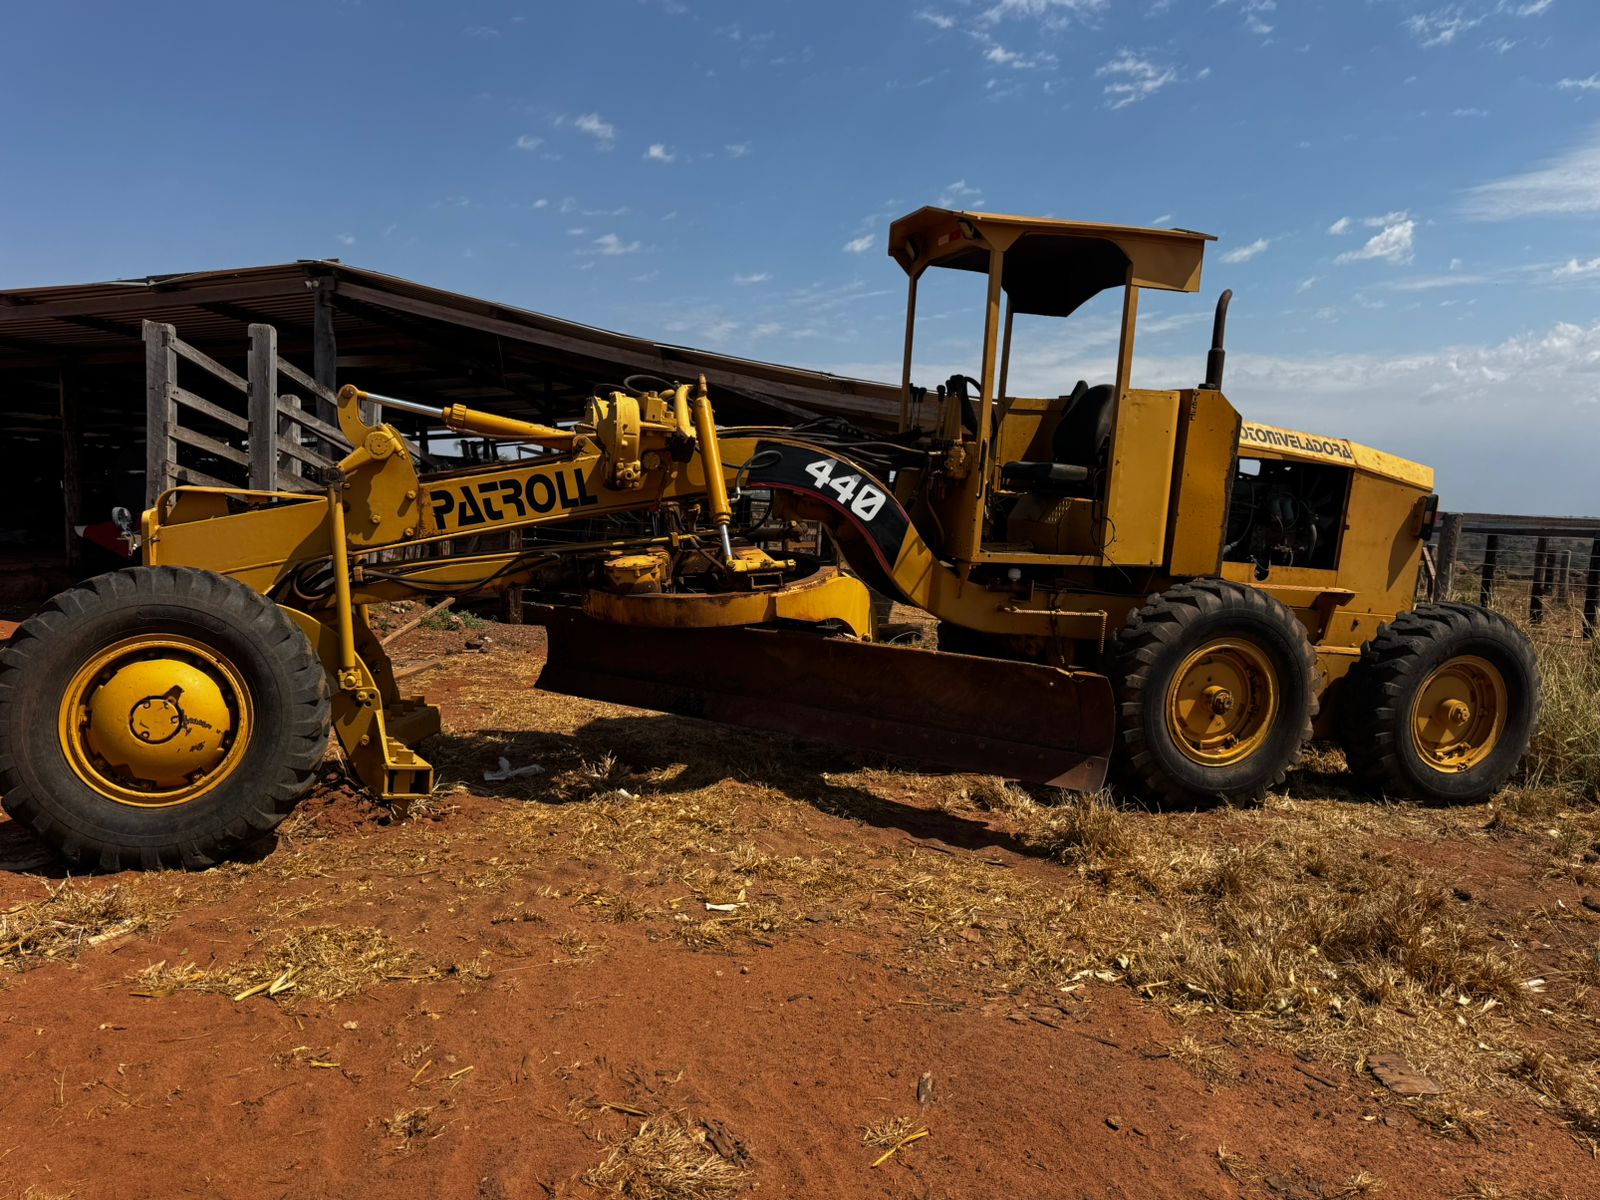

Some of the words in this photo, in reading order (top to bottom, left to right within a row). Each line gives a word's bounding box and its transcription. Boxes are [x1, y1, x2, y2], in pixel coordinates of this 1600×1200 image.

[1240, 426, 1352, 459] OTONIVELADORA
[430, 467, 599, 530] PATROLL
[805, 458, 887, 522] 440
